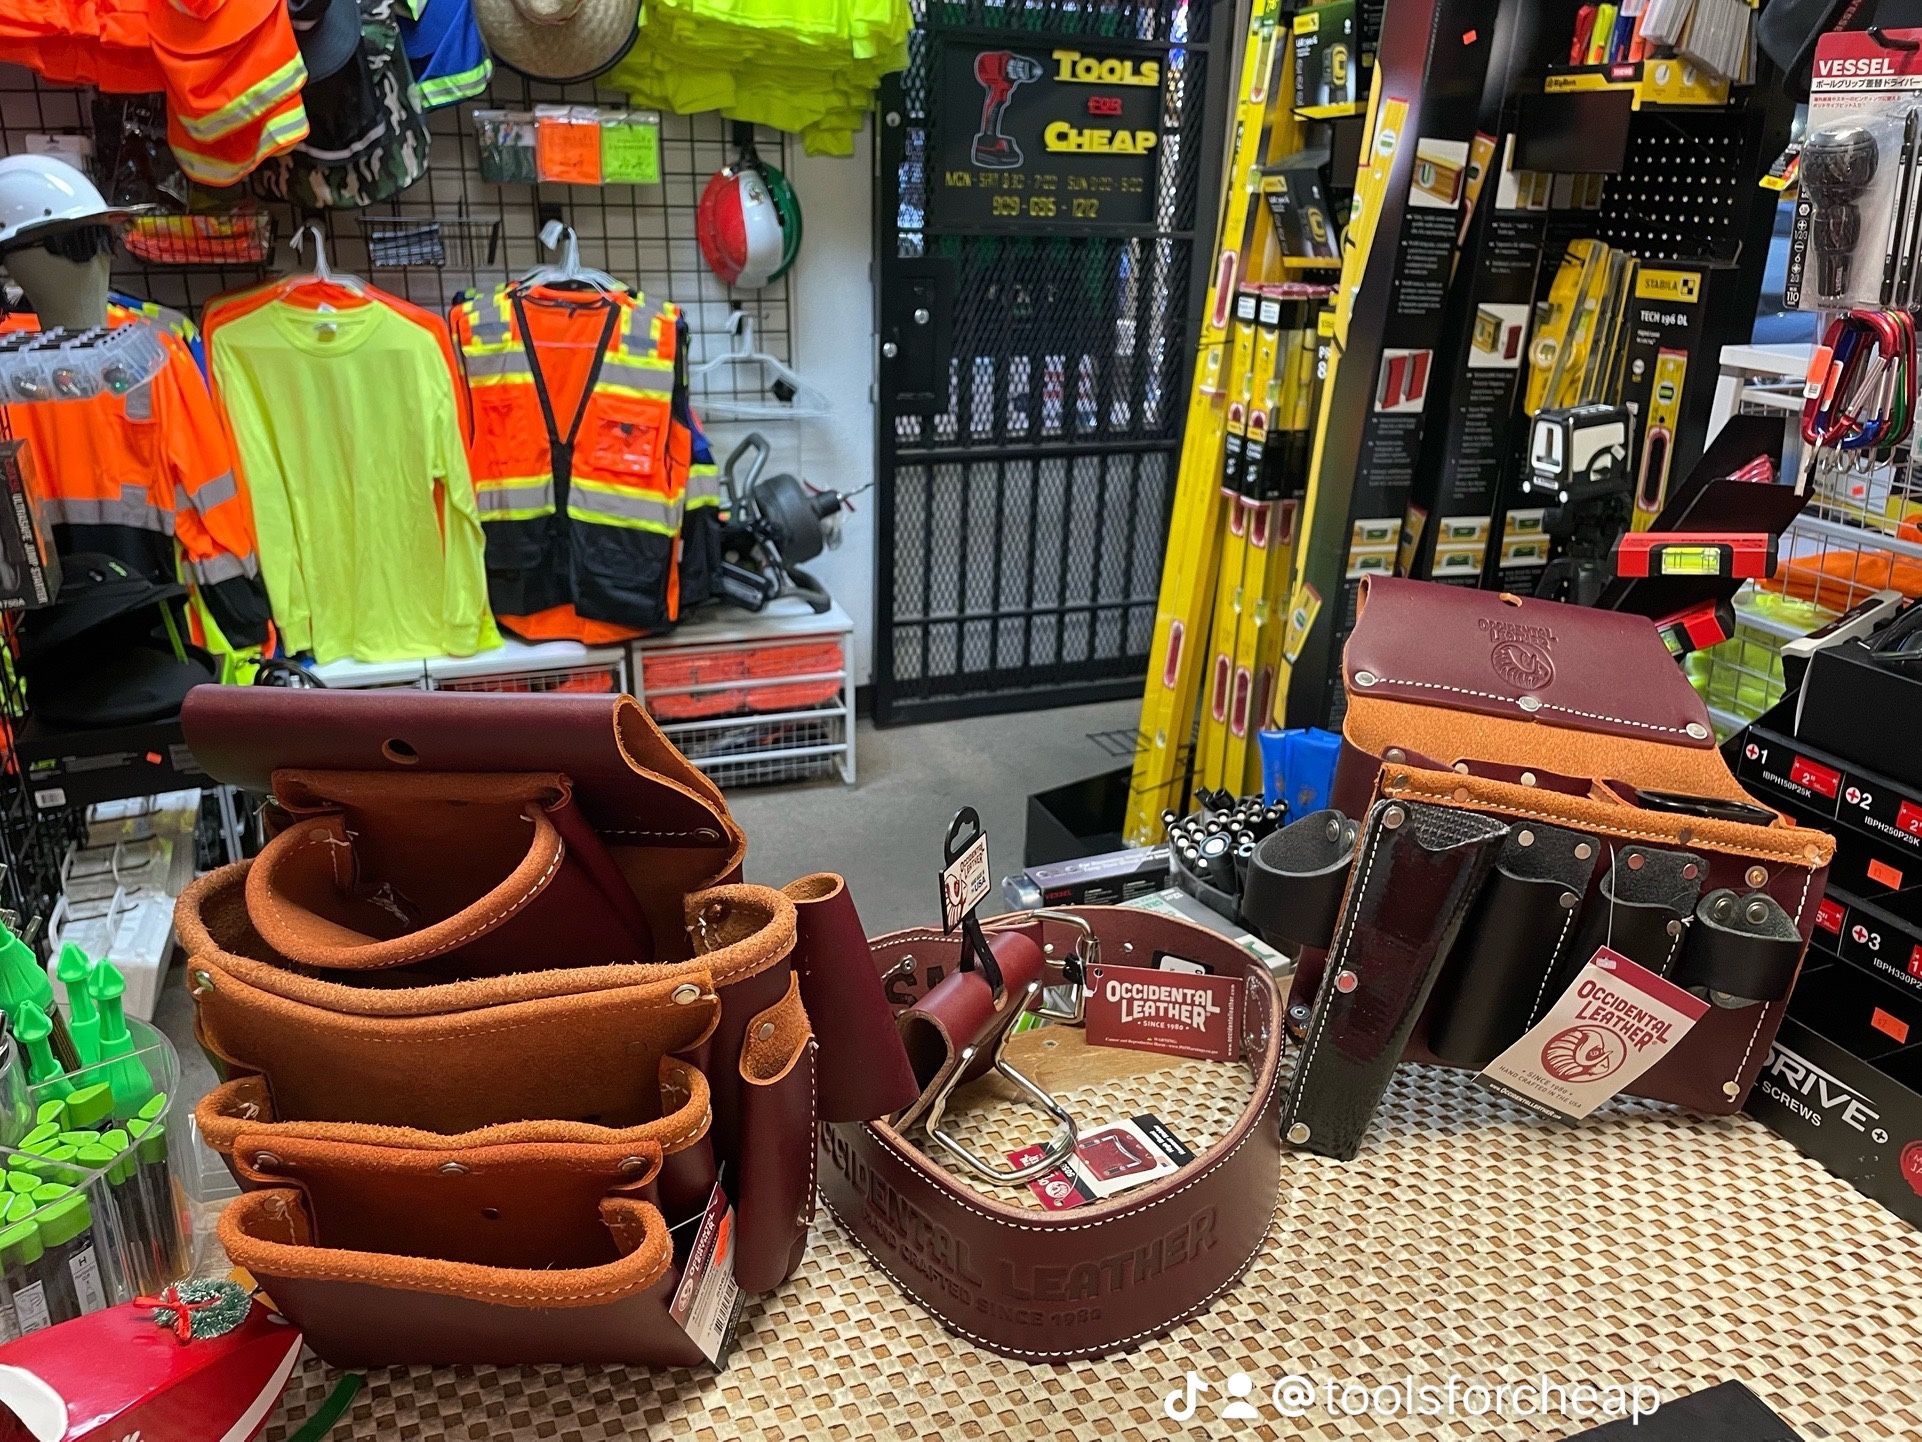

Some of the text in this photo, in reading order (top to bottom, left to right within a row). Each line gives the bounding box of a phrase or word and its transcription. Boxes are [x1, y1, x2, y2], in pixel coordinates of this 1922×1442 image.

[1052, 50, 1160, 86] TOOLS
[1819, 58, 1895, 76] VESSEL
[1088, 96, 1122, 116] FOR
[1044, 121, 1158, 152] CHEAP
[945, 171, 972, 188] MON
[1067, 175, 1088, 191] SUN
[1794, 254, 1801, 263] 6
[1645, 278, 1678, 292] STABILA
[1786, 291, 1800, 302] 110
[1640, 310, 1660, 323] TECH
[1677, 314, 1688, 327] DL
[1761, 749, 1769, 765] 1
[1762, 770, 1812, 799] IBPH150P25K
[1859, 793, 1873, 811] 2
[1864, 815, 1921, 848] IBPH250P25K
[974, 876, 986, 892] USA
[1868, 932, 1881, 951] 3
[1106, 980, 1221, 1014] OCCIDENTAL
[1121, 999, 1206, 1032] LEATHER
[1577, 979, 1674, 1044] OCCIDENTAL
[1143, 1020, 1184, 1031] SINCE 1980
[1575, 1000, 1655, 1053] LEATHER
[1499, 1065, 1518, 1080] HAND
[1518, 1074, 1547, 1094] CRAFTED
[1547, 1089, 1555, 1099] IN
[1555, 1092, 1568, 1105] THE
[1527, 1071, 1568, 1095] SINCE 1980
[1762, 1080, 1822, 1127] SCREWS
[820, 1121, 983, 1289] CCIDENTAL
[1000, 1204, 1217, 1301] LEATHER
[899, 1243, 972, 1306] CRAFTED
[977, 1296, 1043, 1328] SINCE
